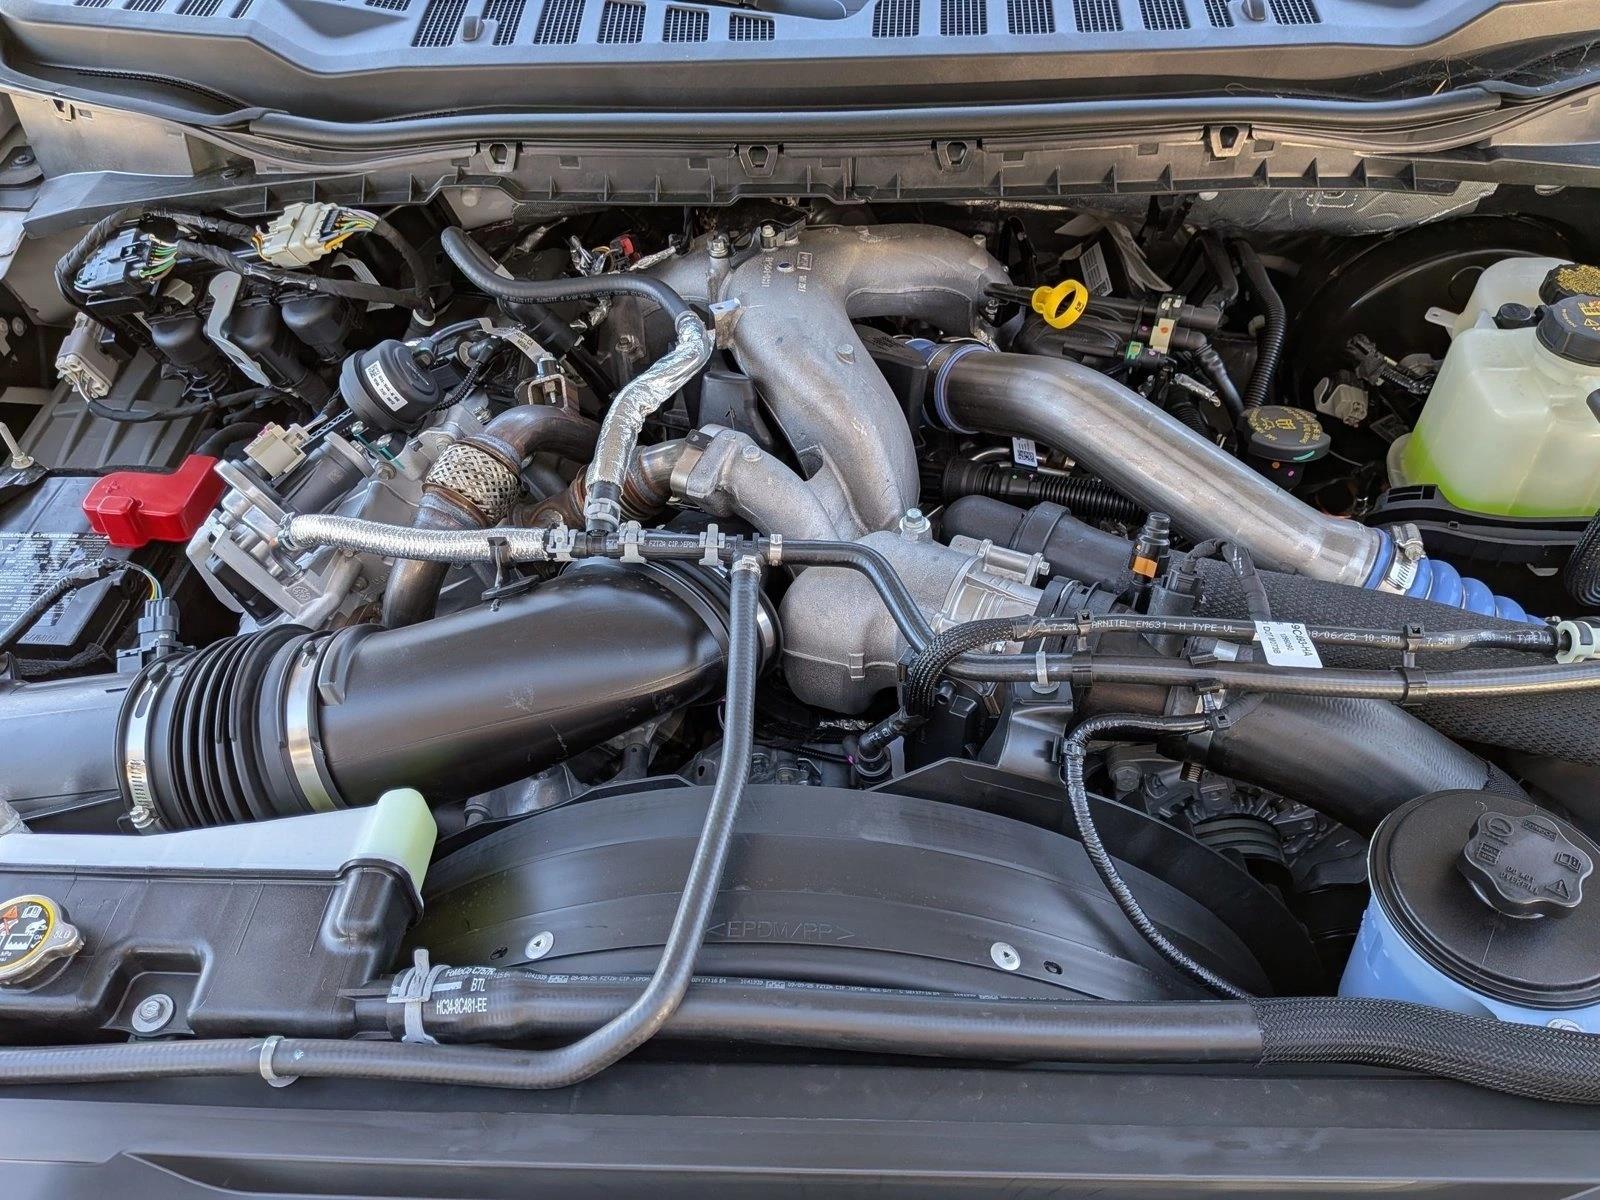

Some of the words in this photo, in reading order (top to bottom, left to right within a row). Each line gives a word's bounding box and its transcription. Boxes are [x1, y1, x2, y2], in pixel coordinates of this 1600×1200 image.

[1091, 619, 1131, 629] ARNITEL
[1136, 620, 1168, 630] EM631
[1192, 623, 1217, 632] TYPE
[1223, 625, 1236, 633] VL
[1517, 634, 1539, 644] TYPE
[470, 978, 485, 992] BTL
